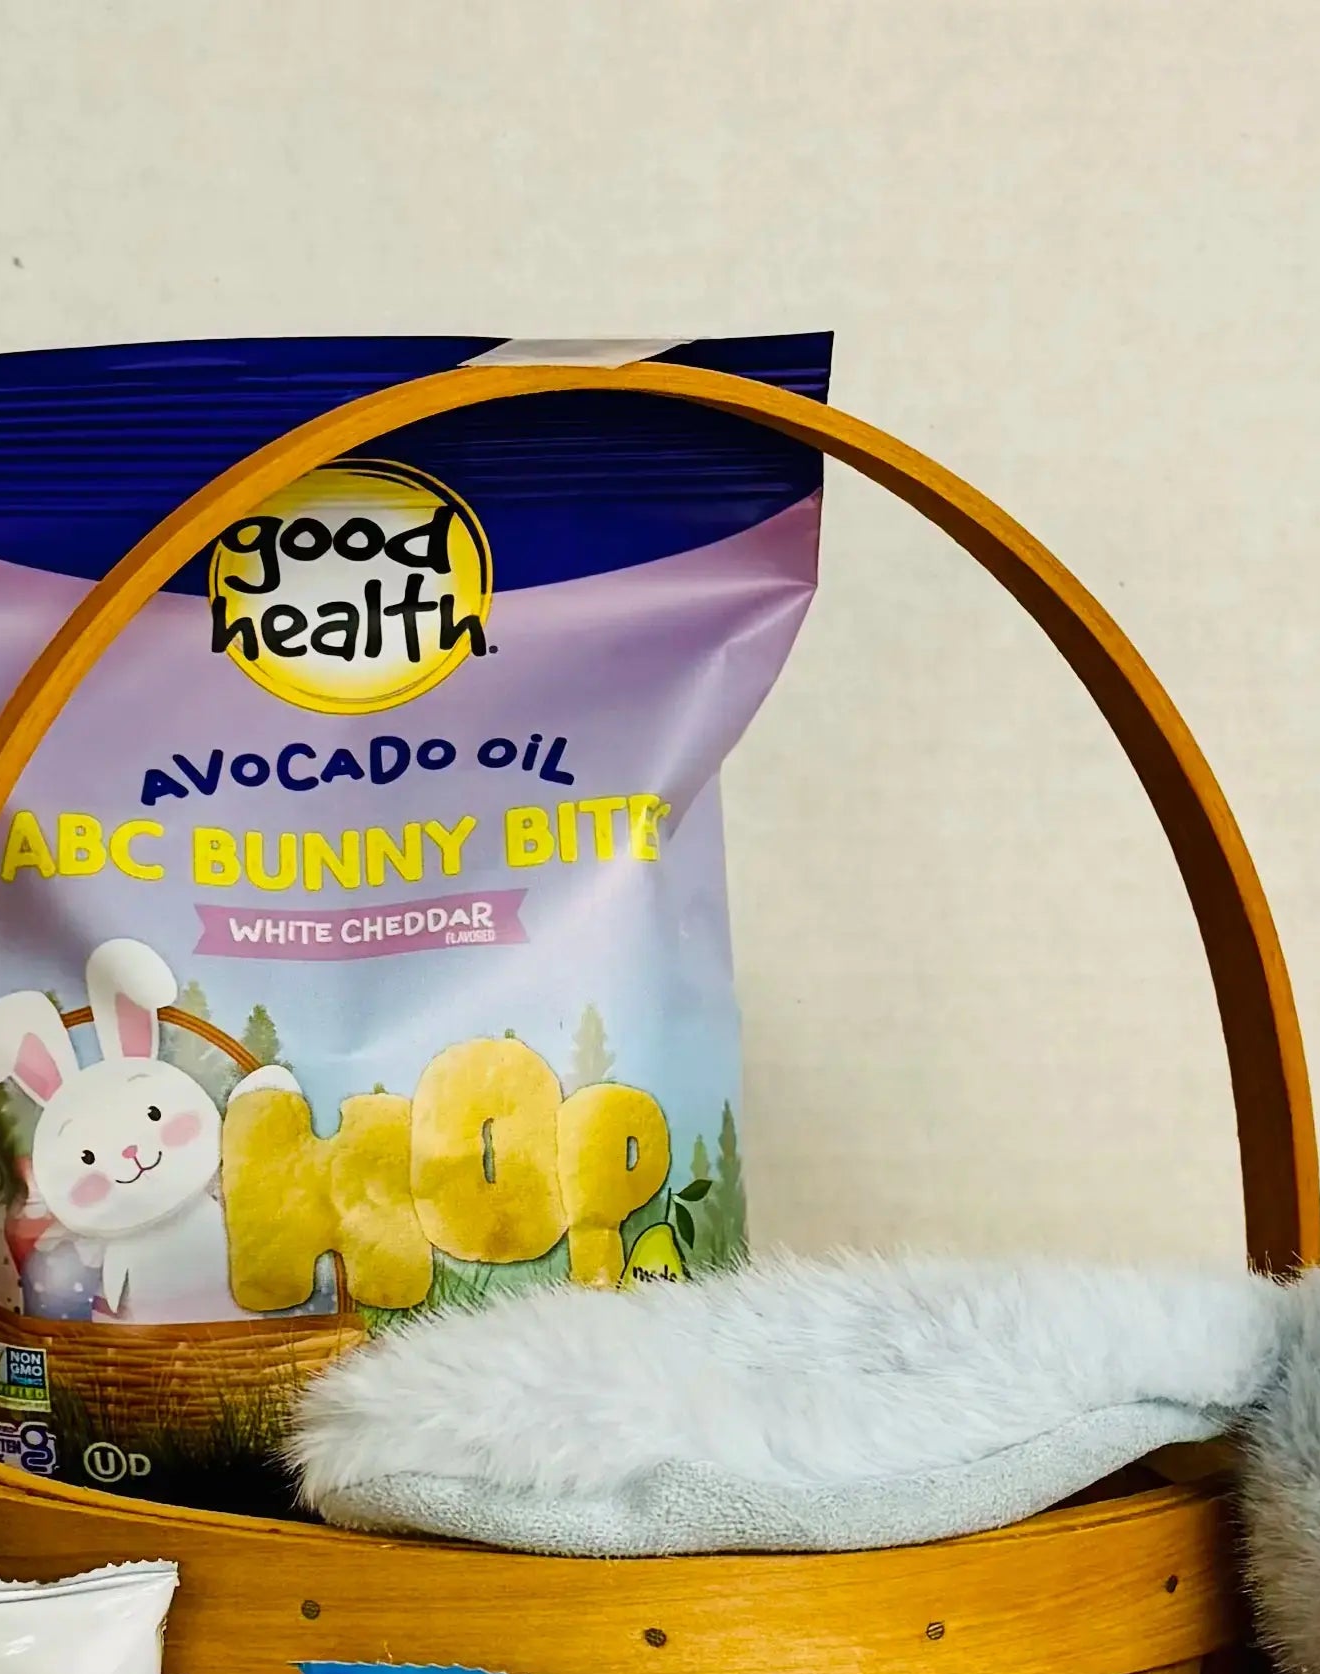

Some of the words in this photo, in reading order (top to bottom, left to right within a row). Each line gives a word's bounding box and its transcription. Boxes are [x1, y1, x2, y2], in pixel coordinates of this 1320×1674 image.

[218, 504, 457, 594] good
[139, 735, 457, 806] AVOCADO
[0, 810, 166, 883] ABC
[192, 816, 477, 892] BUNNY
[505, 793, 672, 868] BITE
[227, 917, 333, 945] WHITE
[340, 901, 495, 945] CHEDDAR
[444, 929, 497, 945] FLAVORED
[222, 1037, 671, 1311] HOP
[10, 1350, 41, 1365] NON
[10, 1362, 43, 1376] GMO
